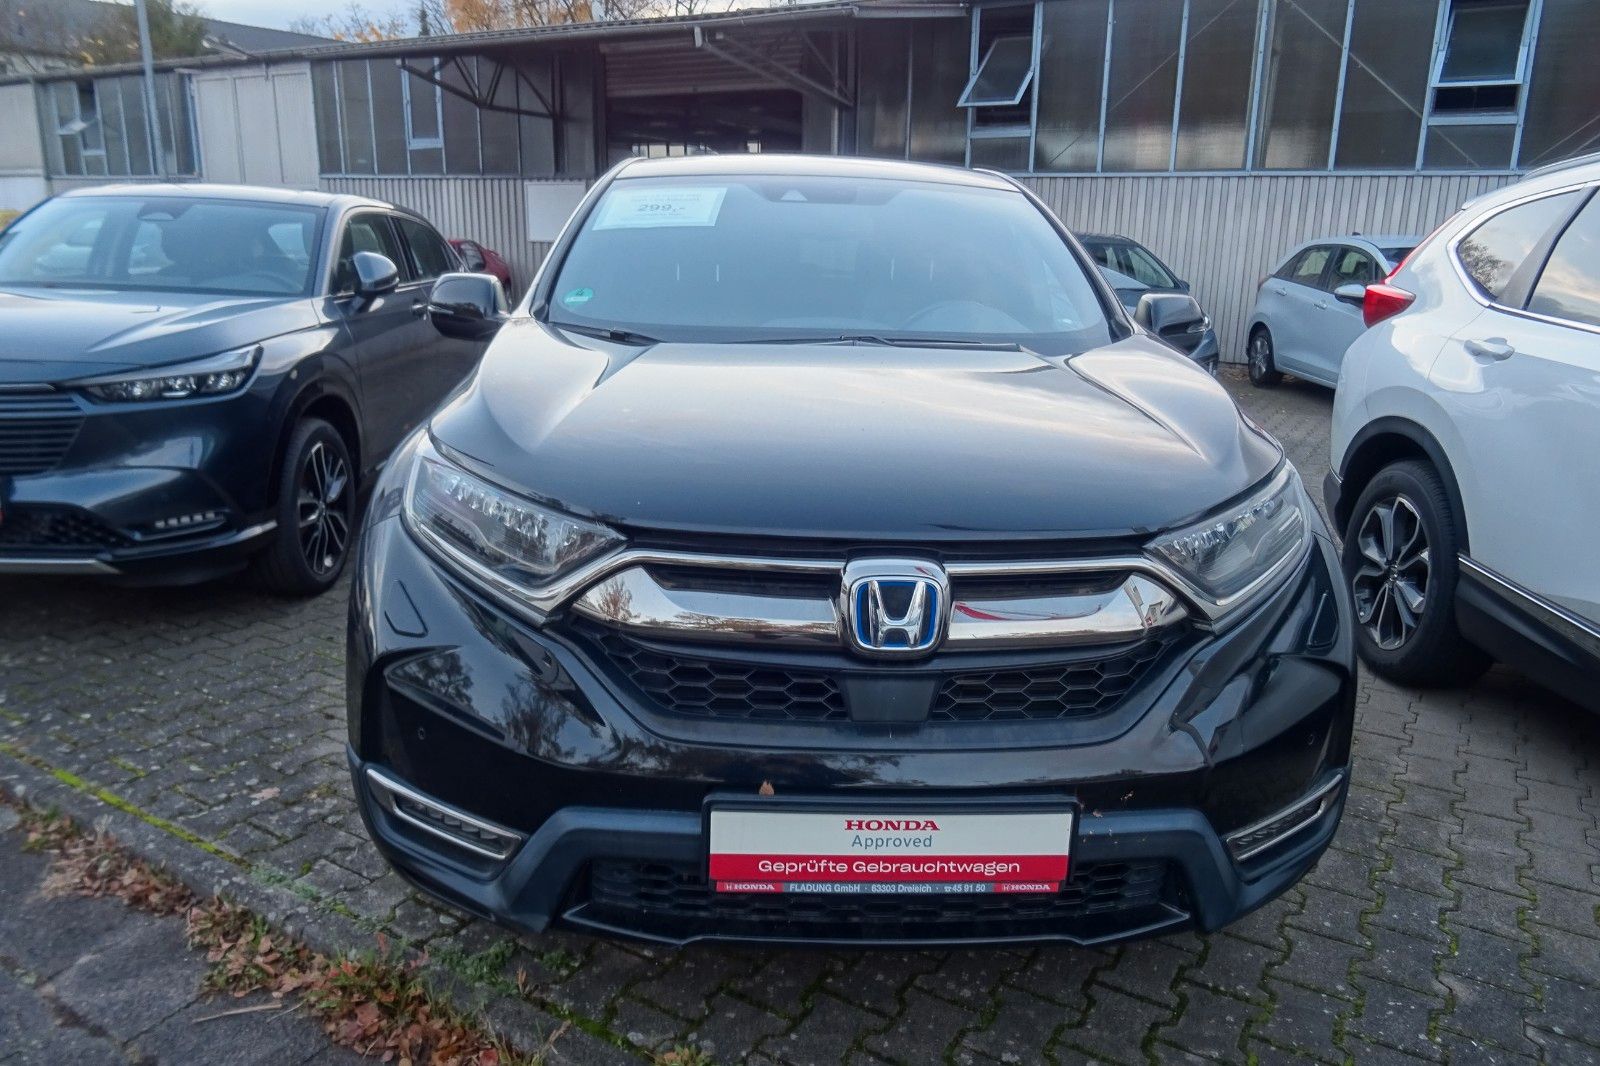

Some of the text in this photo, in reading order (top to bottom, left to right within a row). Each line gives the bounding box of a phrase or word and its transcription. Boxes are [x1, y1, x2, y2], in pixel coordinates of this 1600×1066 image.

[845, 819, 940, 831] HONDA
[851, 834, 933, 850] Approved
[758, 860, 1020, 876] Geprüfte Gebrauchtwagen
[789, 882, 832, 892] FLADUNG
[833, 882, 860, 892] GmbH
[871, 882, 896, 892] 63303
[897, 882, 932, 892] Dreieich
